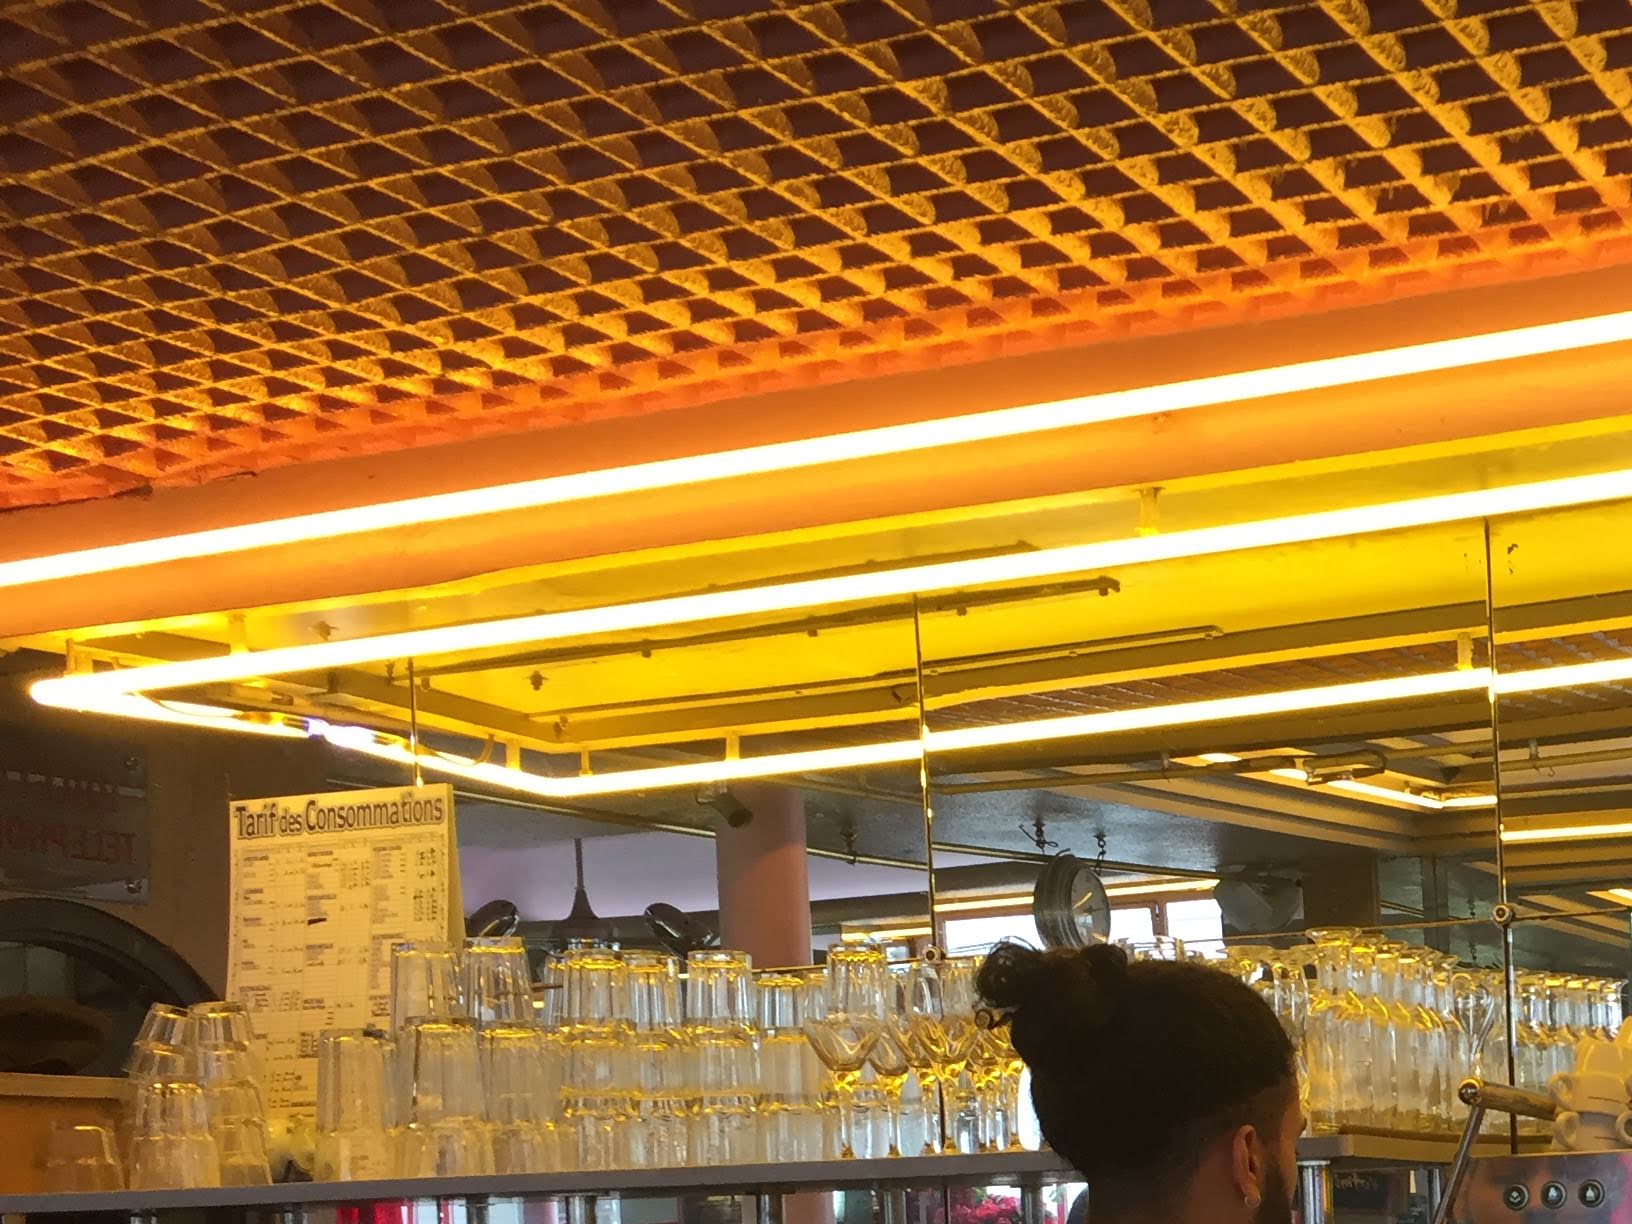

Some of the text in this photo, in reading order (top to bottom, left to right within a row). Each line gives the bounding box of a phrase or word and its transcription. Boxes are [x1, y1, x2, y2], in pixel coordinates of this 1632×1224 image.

[236, 793, 443, 837] Tarif des Consommations
